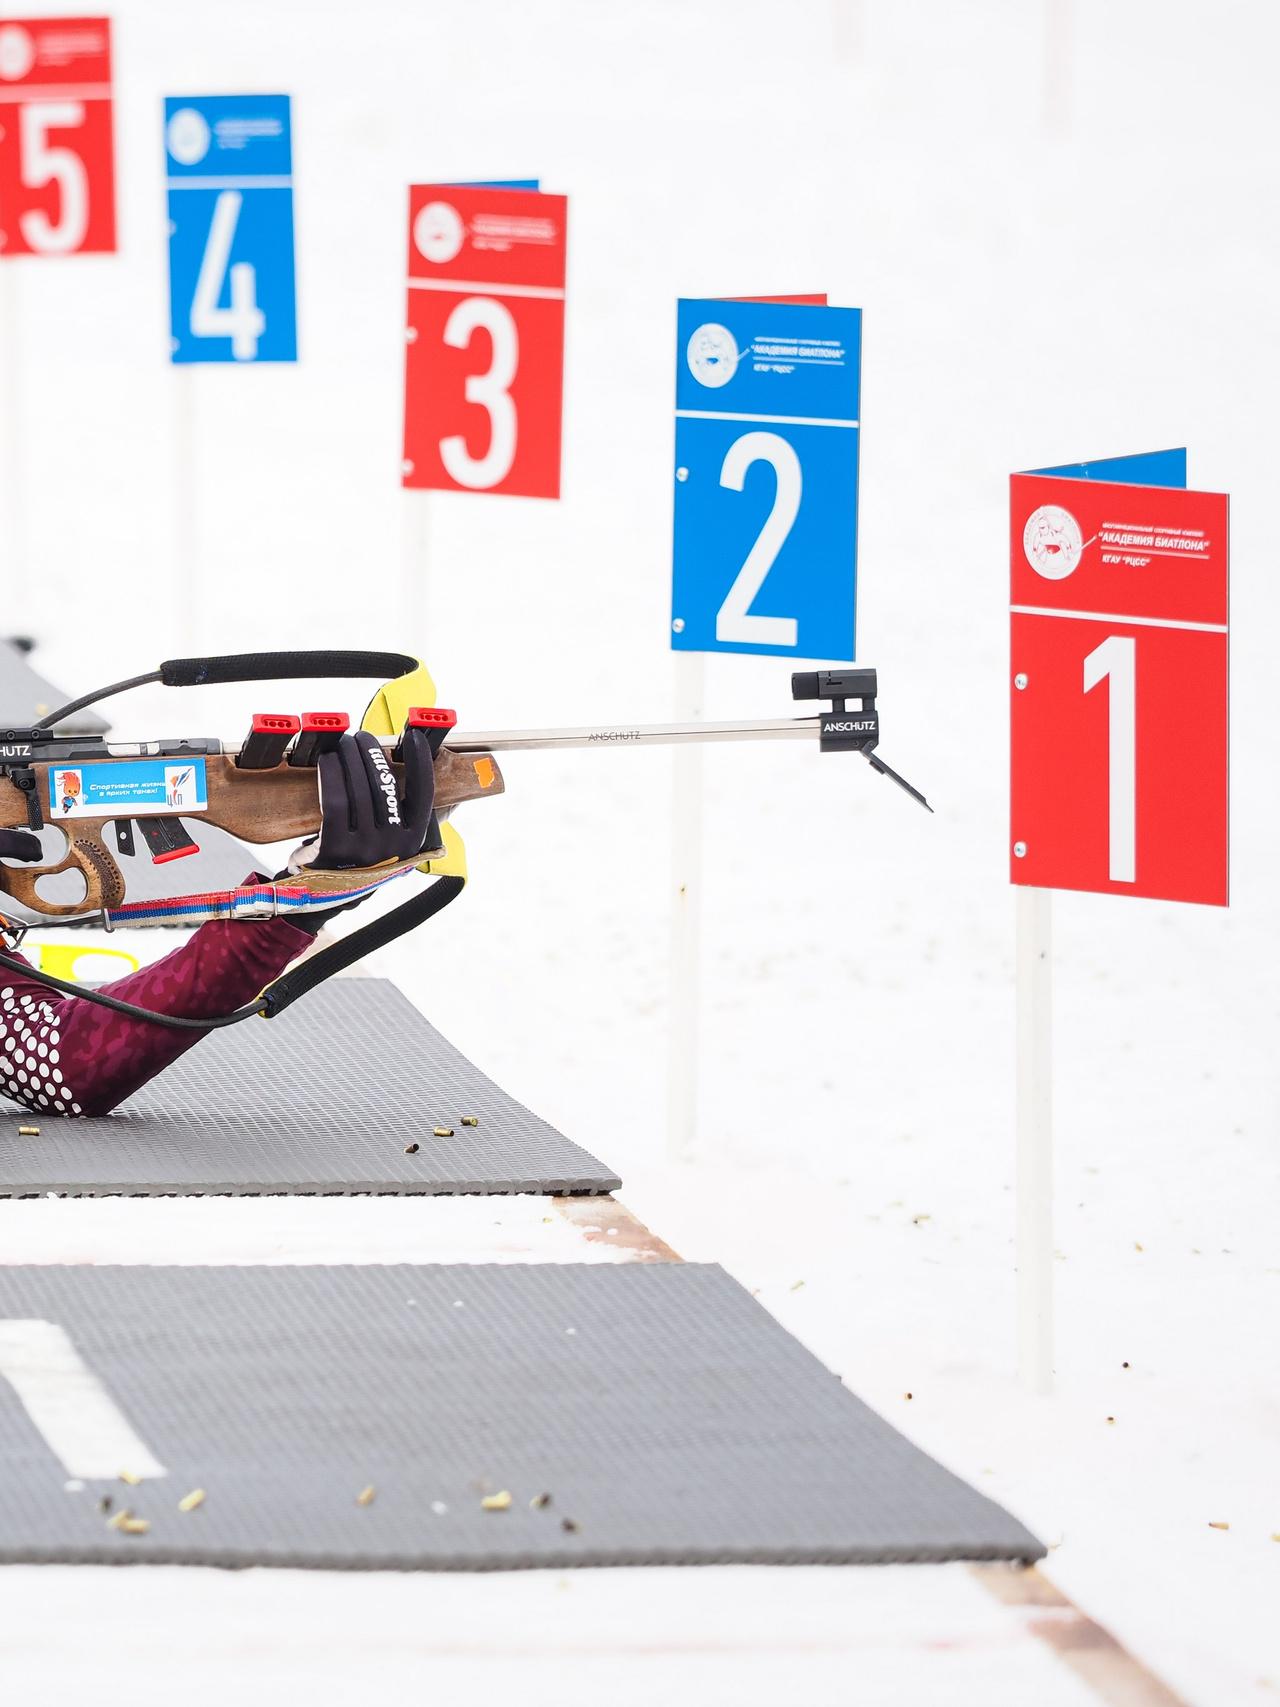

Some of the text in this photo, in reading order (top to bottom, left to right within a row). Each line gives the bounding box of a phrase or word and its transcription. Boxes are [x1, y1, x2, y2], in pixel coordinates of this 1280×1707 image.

[20, 103, 89, 254] 5
[190, 190, 266, 360] 4
[439, 296, 519, 489] 3
[715, 431, 803, 647] 2
[89, 782, 139, 791] Спортивная
[106, 789, 130, 797] ярких
[1083, 635, 1136, 883] 1
